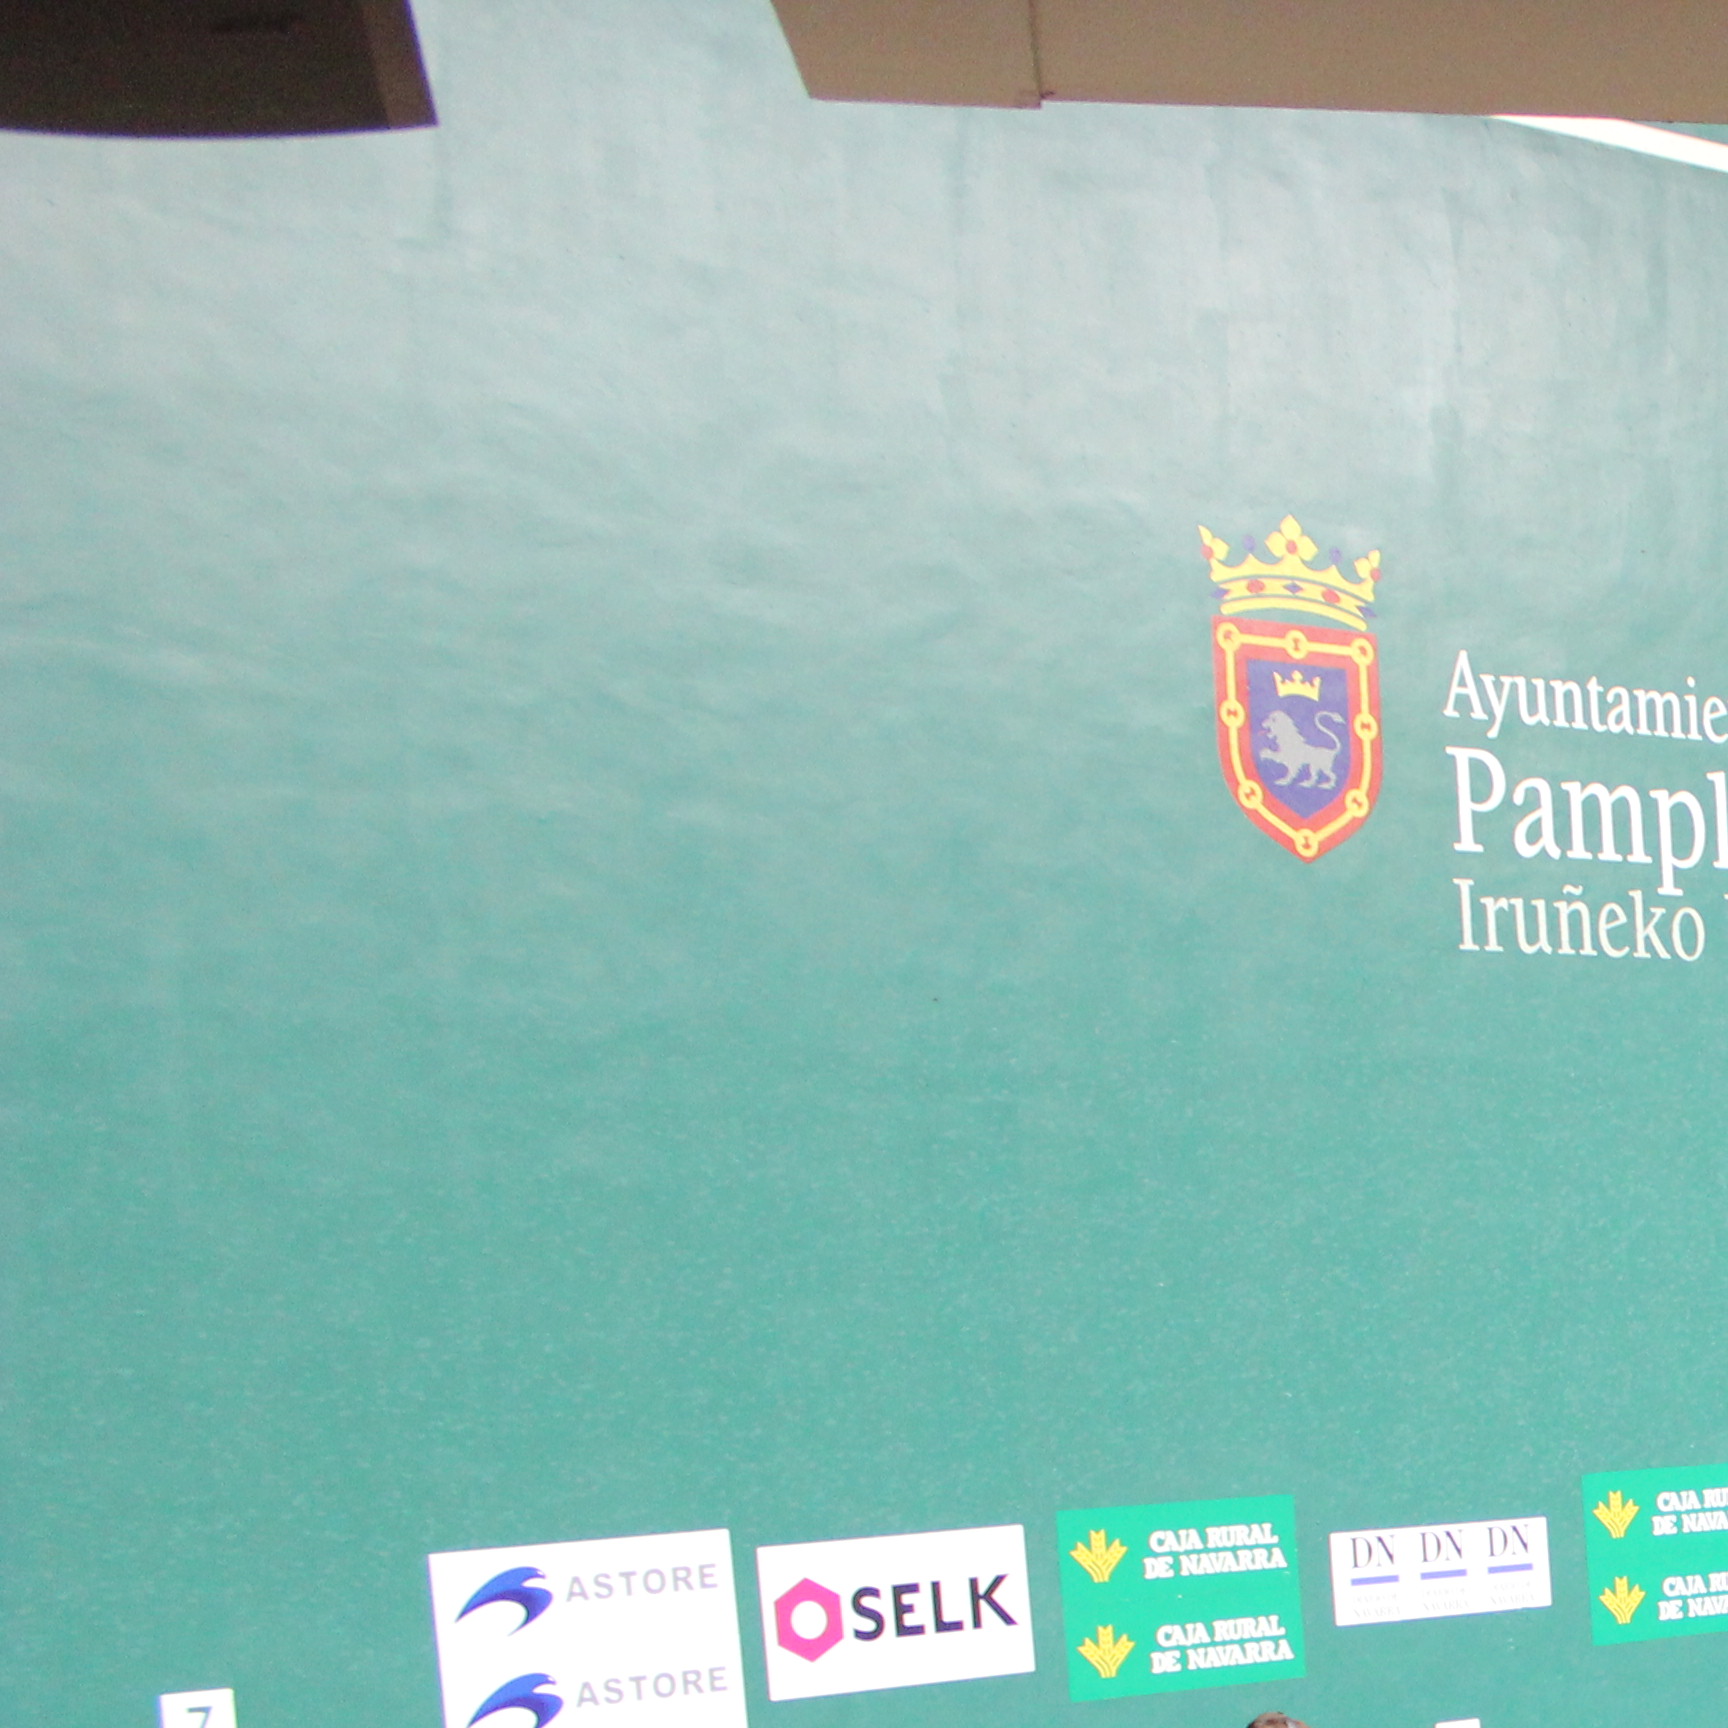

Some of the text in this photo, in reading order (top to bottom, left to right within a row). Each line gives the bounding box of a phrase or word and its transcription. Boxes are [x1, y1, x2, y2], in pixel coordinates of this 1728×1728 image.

[1452, 877, 1706, 963] Iruñeko
[1656, 1491, 1702, 1514] CAJA
[1149, 1522, 1280, 1554] CAJA RURAL
[1487, 1524, 1529, 1558] DN
[1651, 1514, 1679, 1536] DE
[1350, 1534, 1396, 1569] DN
[1419, 1529, 1464, 1563] DN
[1142, 1547, 1288, 1580] DE NAVARRA
[565, 1562, 720, 1604] ASTORE
[1662, 1574, 1707, 1598] CAJA
[850, 1573, 1020, 1643] SELK
[1657, 1598, 1684, 1621] DE
[1155, 1615, 1287, 1648] CAJA RURAL
[1149, 1640, 1296, 1675] DE NAVARRA
[575, 1665, 730, 1709] ASTORE
